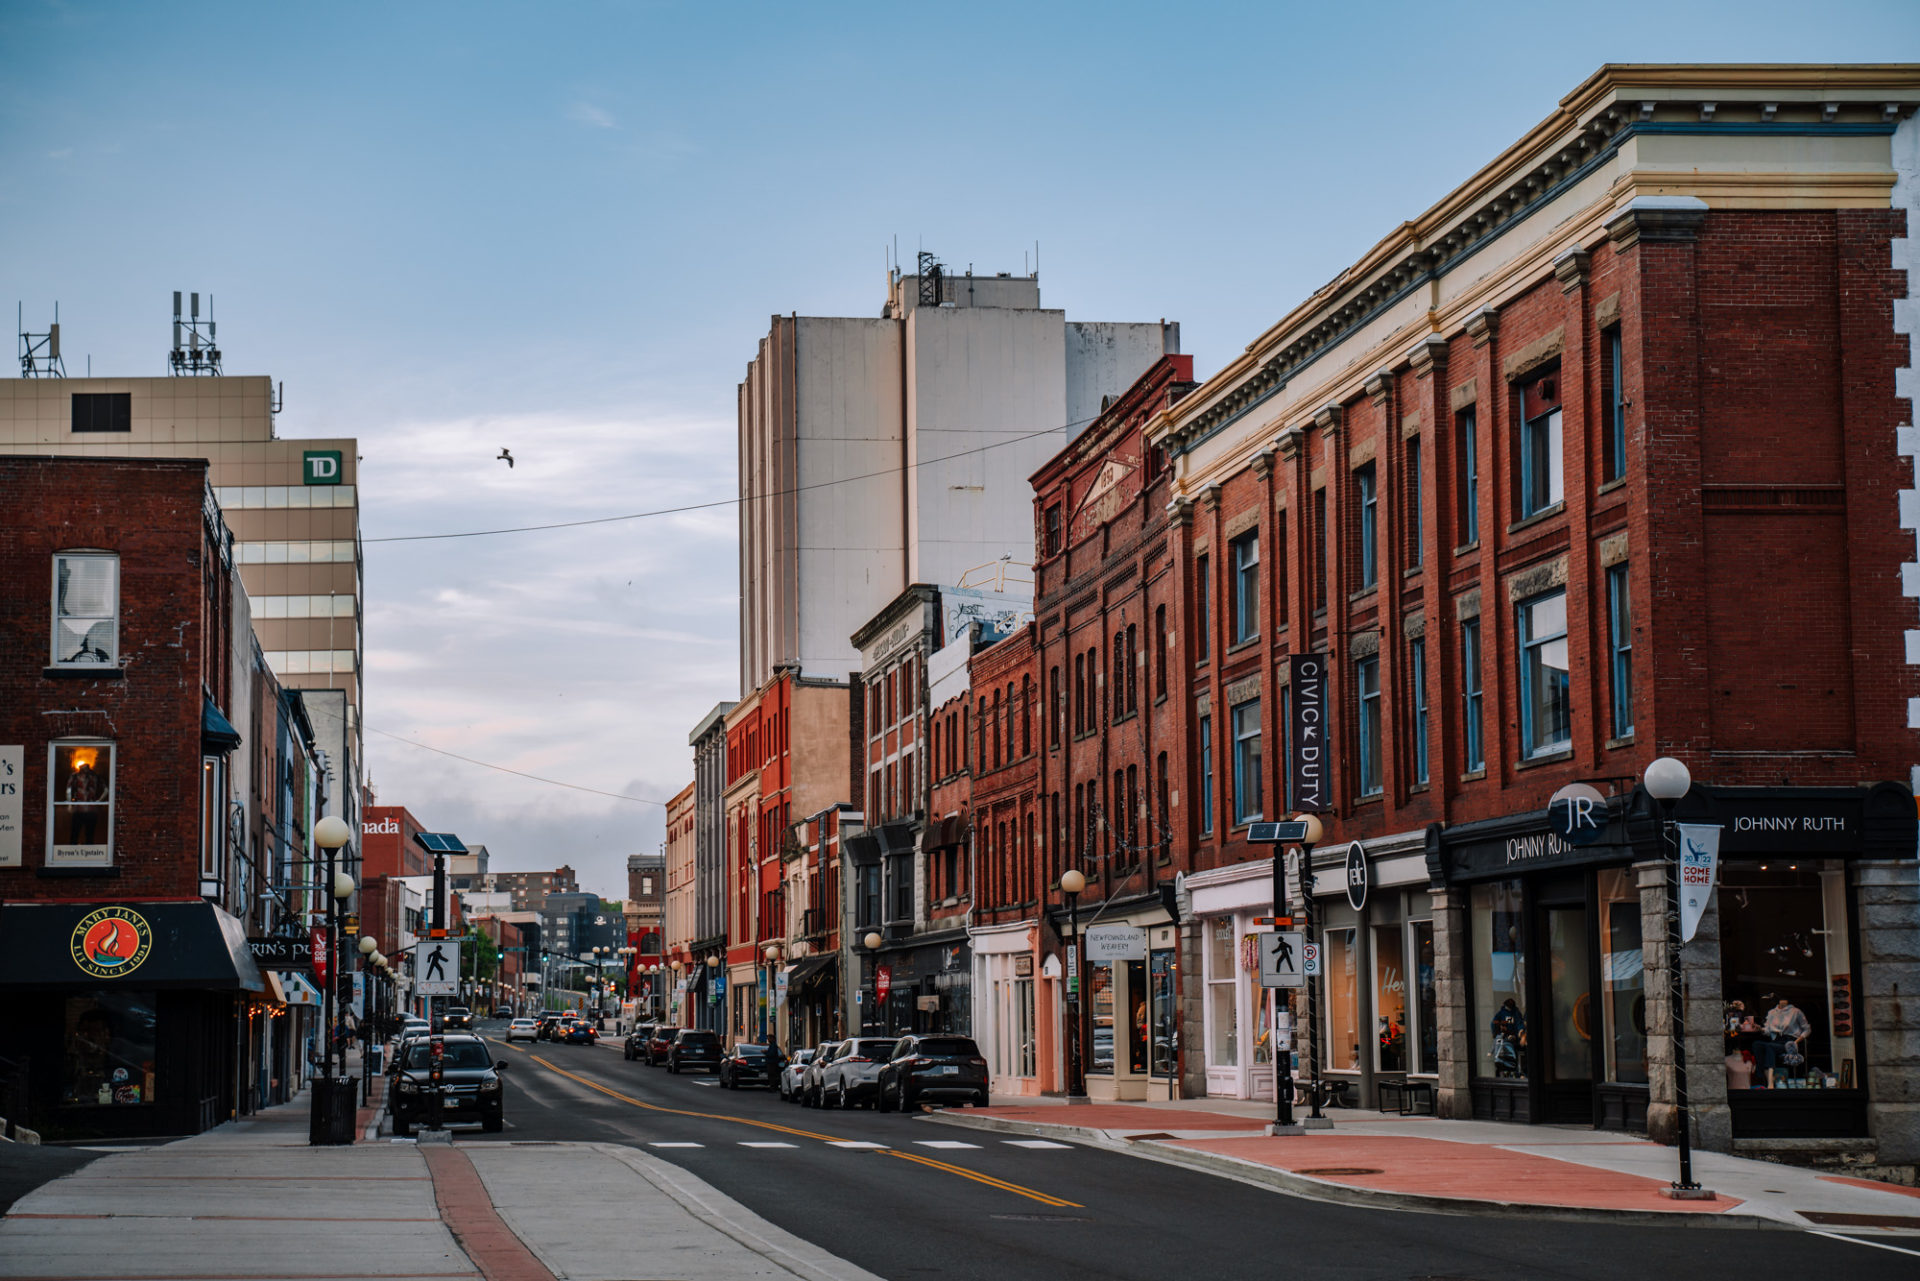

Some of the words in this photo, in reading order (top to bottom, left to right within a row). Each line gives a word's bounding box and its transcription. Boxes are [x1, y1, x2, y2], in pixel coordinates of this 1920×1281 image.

[306, 456, 337, 478] TD
[1300, 661, 1319, 723] CIVIC
[1302, 746, 1319, 806] DUTY
[361, 817, 399, 834] nada
[1565, 796, 1597, 834] JR
[1734, 817, 1798, 833] JOHNNY
[1803, 817, 1845, 831] RUTH
[1506, 834, 1545, 865] JOHNNY
[1702, 855, 1711, 863] 22
[1683, 866, 1711, 875] COME
[1684, 875, 1710, 884] HOME
[77, 909, 109, 936] MARY
[74, 945, 87, 963] LIT
[87, 963, 127, 975] SINCE
